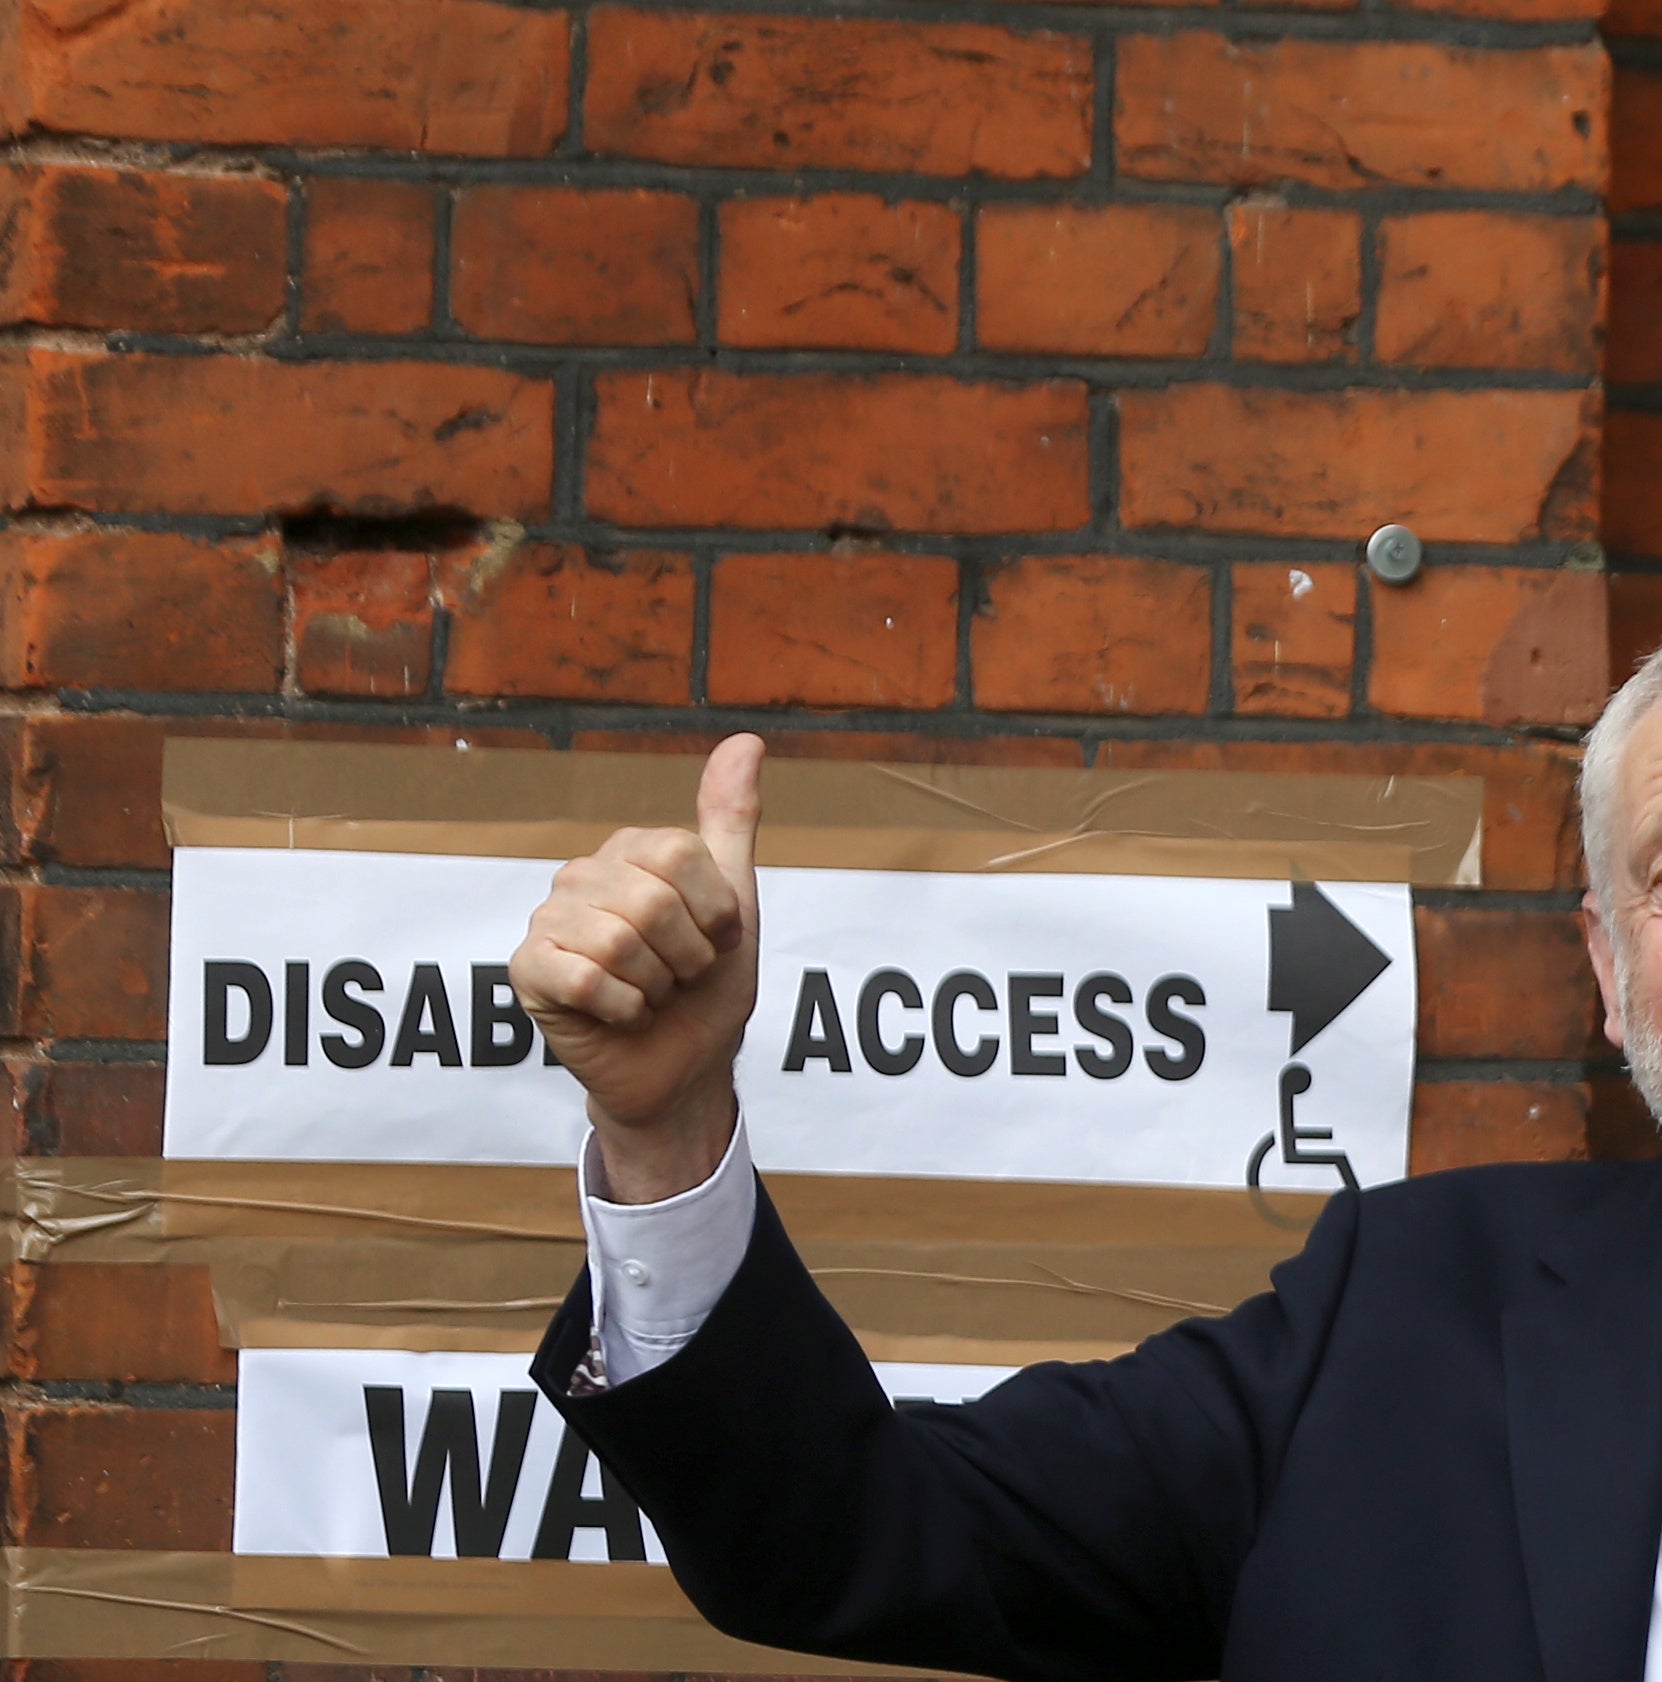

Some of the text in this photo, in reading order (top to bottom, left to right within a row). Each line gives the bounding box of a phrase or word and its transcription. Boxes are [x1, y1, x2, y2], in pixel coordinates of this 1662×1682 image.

[203, 959, 1208, 1080] DISAB ACCESS
[364, 1386, 648, 1562] WA
